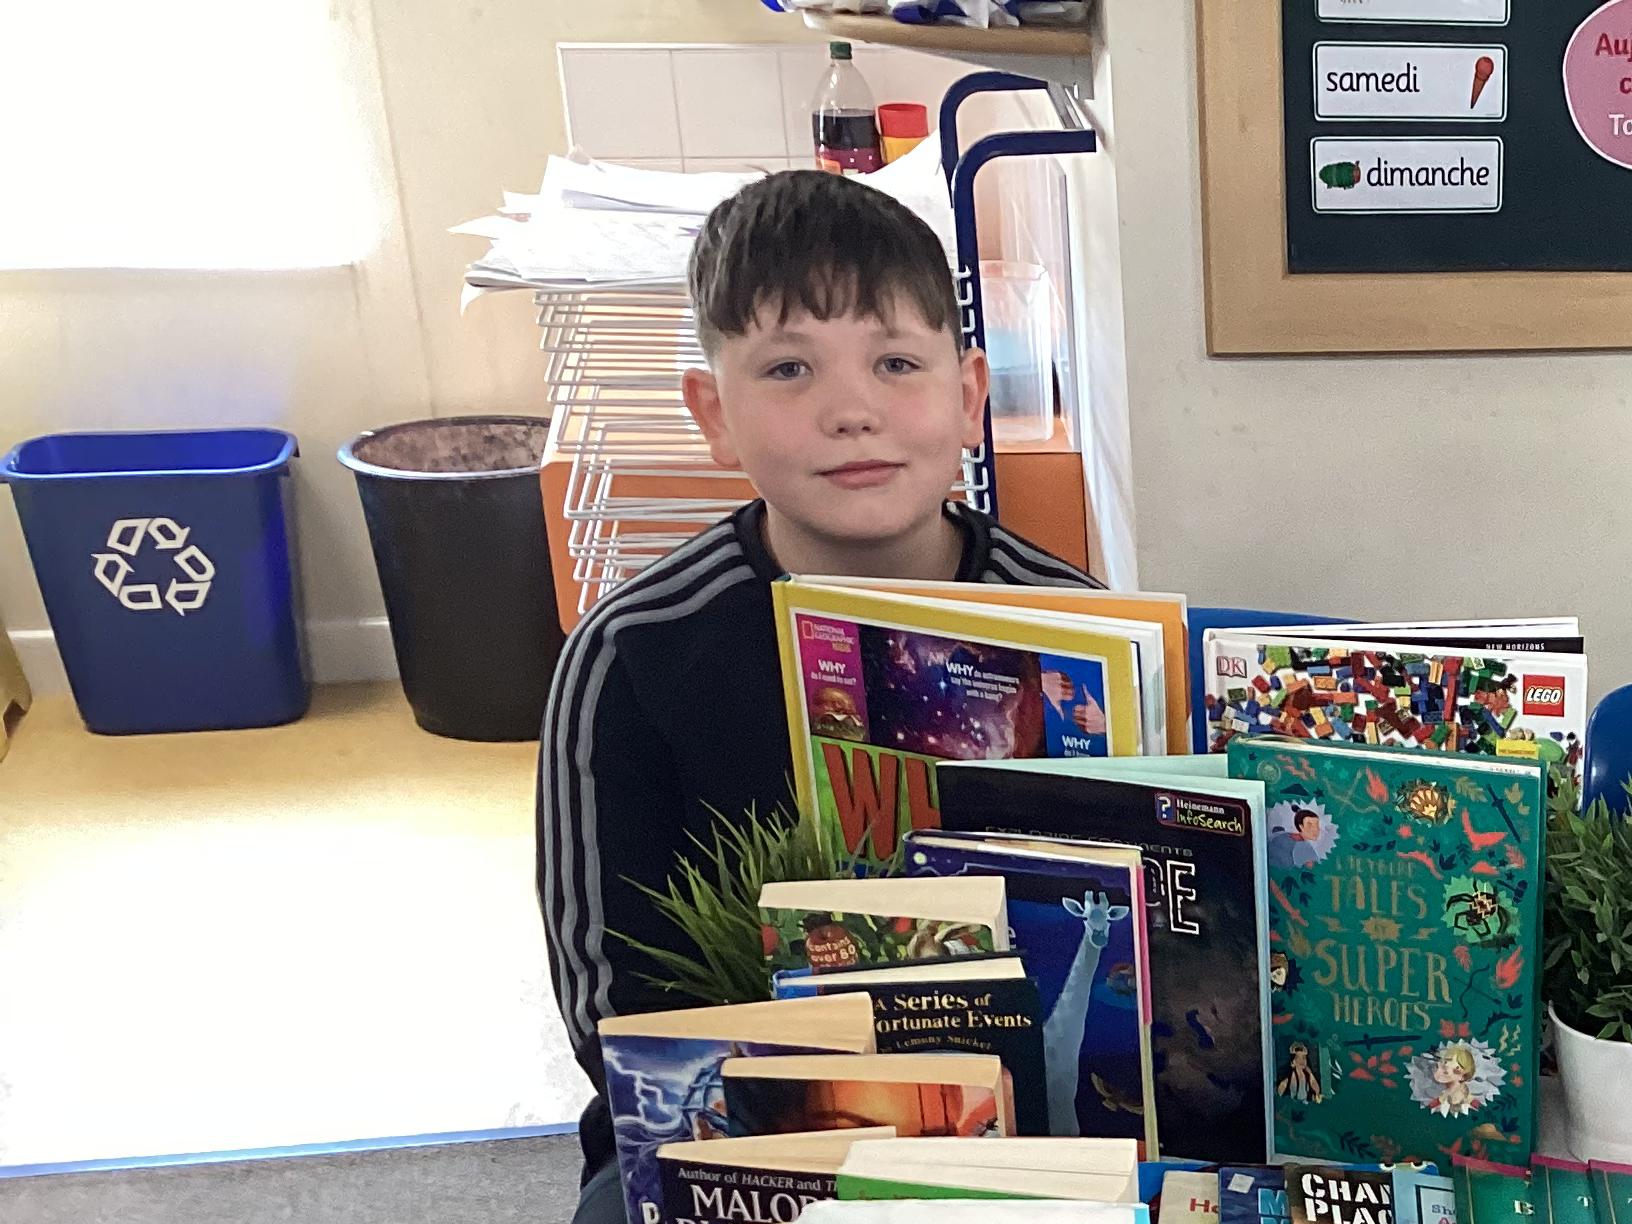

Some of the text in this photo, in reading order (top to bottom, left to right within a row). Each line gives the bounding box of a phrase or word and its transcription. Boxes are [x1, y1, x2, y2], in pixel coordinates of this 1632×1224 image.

[1326, 65, 1420, 92] samedi
[1366, 159, 1490, 188] dimanche
[818, 660, 845, 674] WHY
[1525, 687, 1561, 705] LEGO
[1062, 736, 1090, 750] WHY
[1177, 800, 1225, 814] Heinemann
[1175, 810, 1243, 832] InfoSearch
[1324, 875, 1428, 919] TALES
[1313, 939, 1452, 1003] SUPER
[894, 993, 991, 1011] Series of
[967, 1011, 1032, 1029] Events
[1333, 994, 1431, 1031] HEROES
